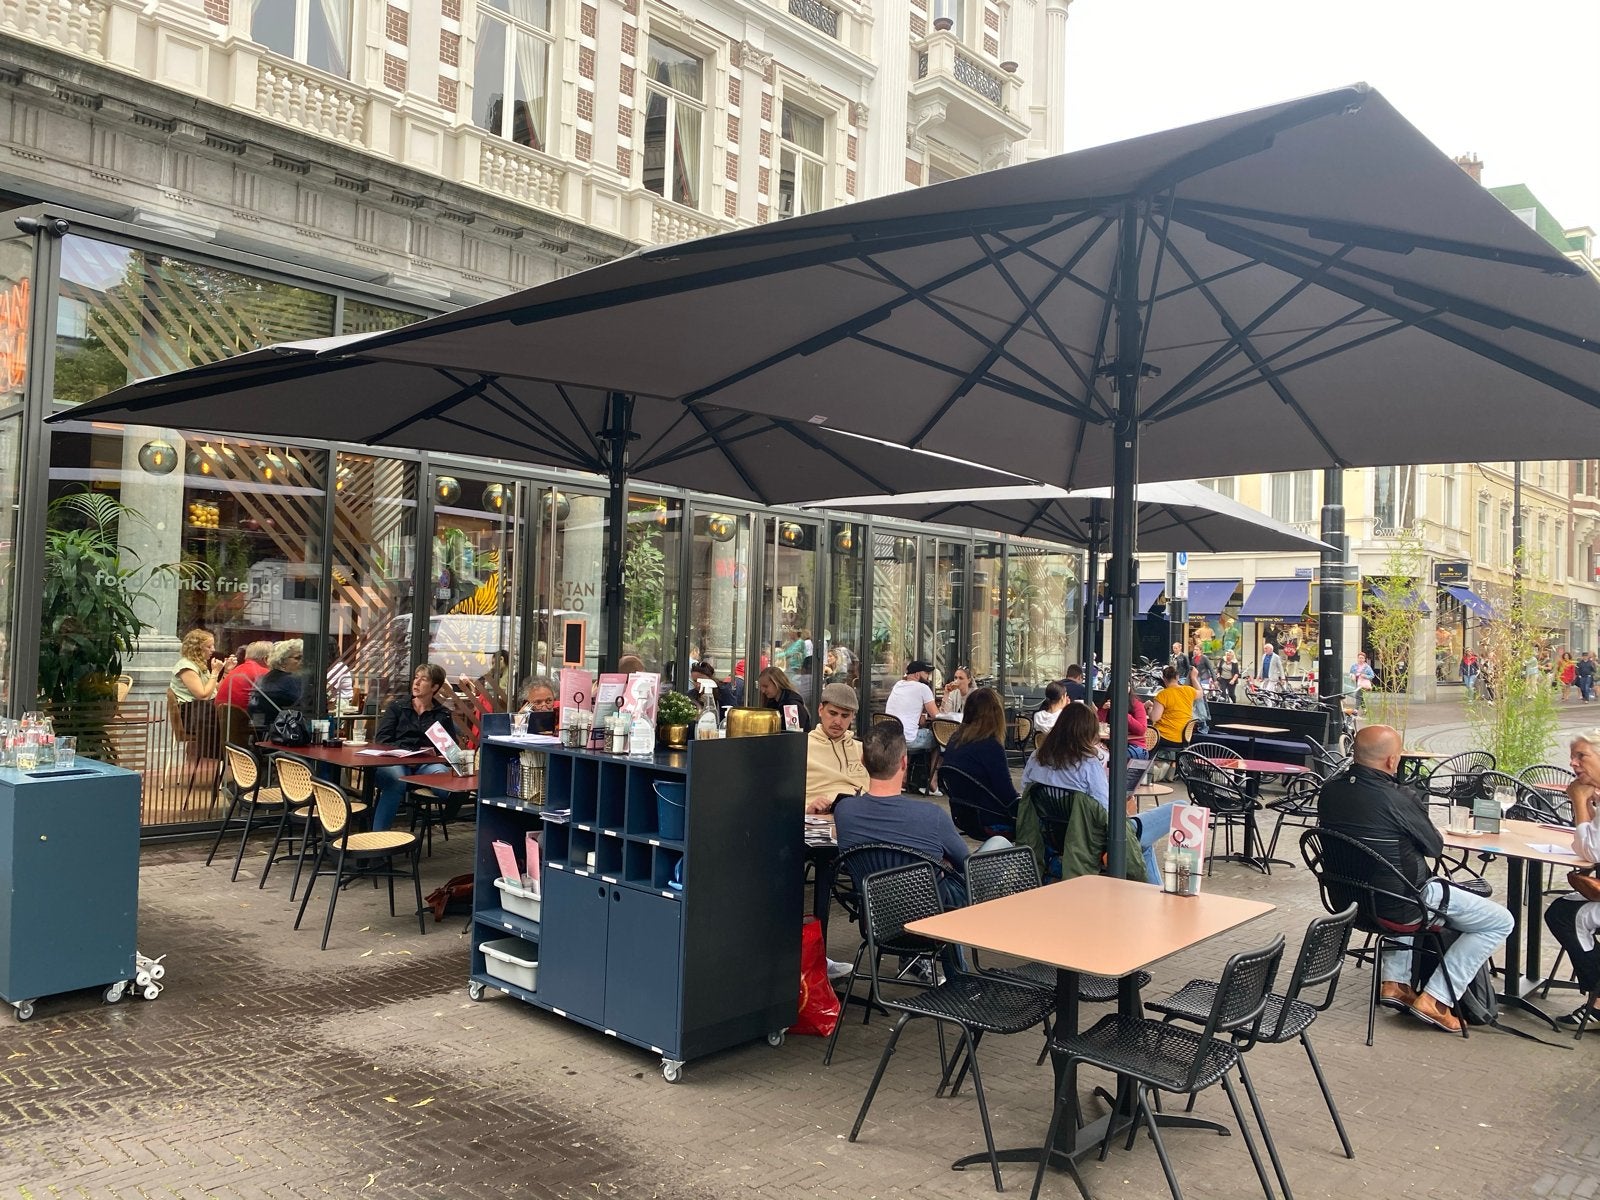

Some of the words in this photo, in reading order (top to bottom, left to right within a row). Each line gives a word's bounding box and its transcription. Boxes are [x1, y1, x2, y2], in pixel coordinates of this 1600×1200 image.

[150, 571, 210, 591] drinks
[217, 576, 280, 595] friends
[554, 580, 595, 597] STAN
[562, 597, 584, 612] CO
